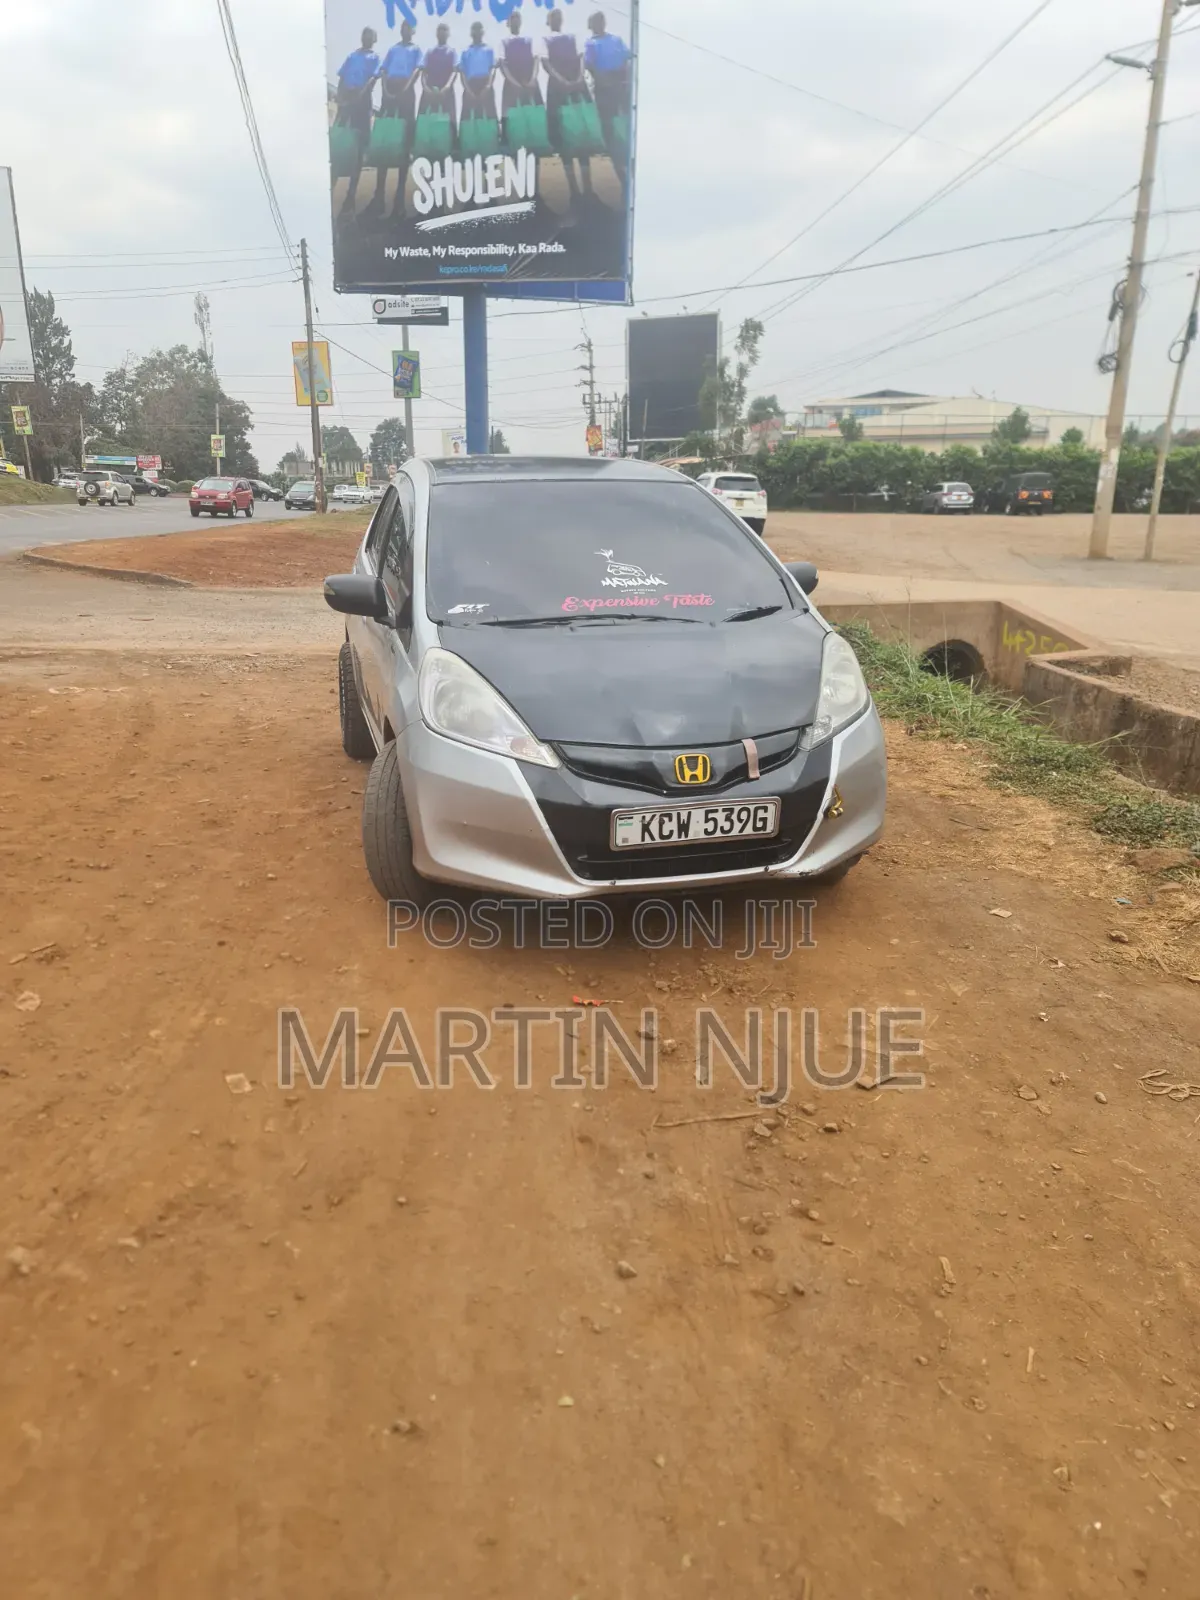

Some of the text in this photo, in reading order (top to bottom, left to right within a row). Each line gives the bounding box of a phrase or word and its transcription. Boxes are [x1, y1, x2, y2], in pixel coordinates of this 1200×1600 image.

[411, 146, 536, 214] SHULENI
[384, 242, 566, 259] My Waste, My Responsibility. Kaa Rada.
[561, 593, 716, 612] Expensive Taste
[640, 805, 769, 842] KCW 539G
